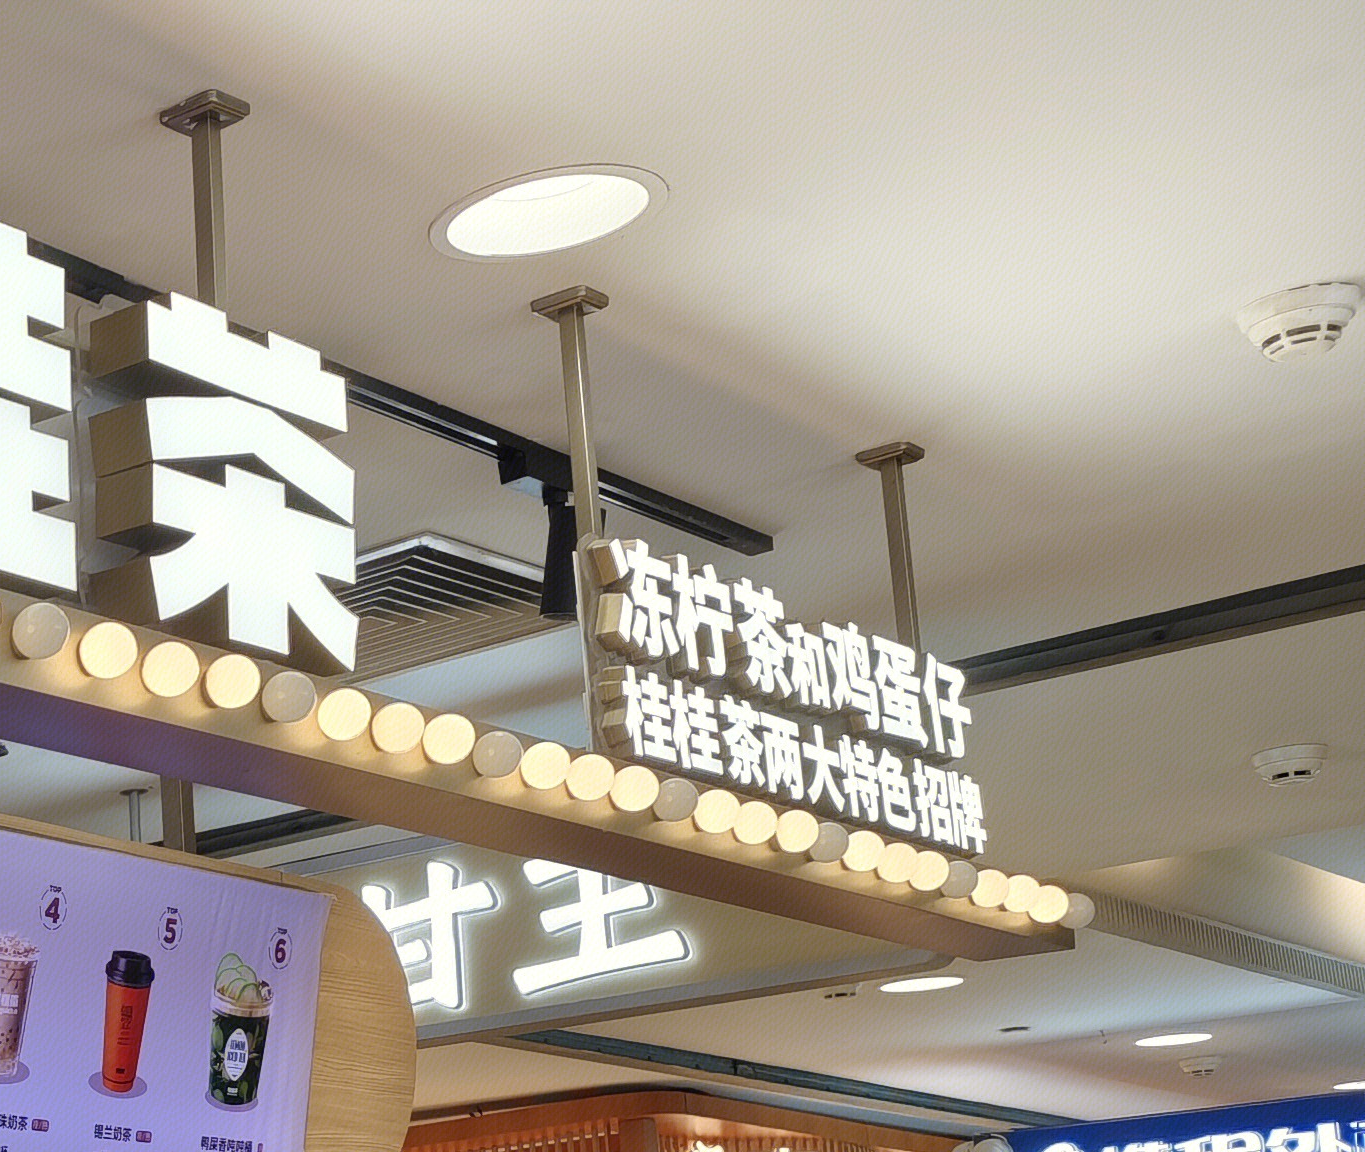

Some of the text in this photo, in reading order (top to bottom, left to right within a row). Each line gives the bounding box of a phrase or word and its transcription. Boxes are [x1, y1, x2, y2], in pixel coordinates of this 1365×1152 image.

[617, 537, 970, 761] 冻柠茶和鸡蛋仔
[623, 666, 986, 854] 桂桂茶两大特色招牌
[45, 897, 60, 923] 4
[164, 918, 178, 944] 5
[275, 938, 287, 964] 6
